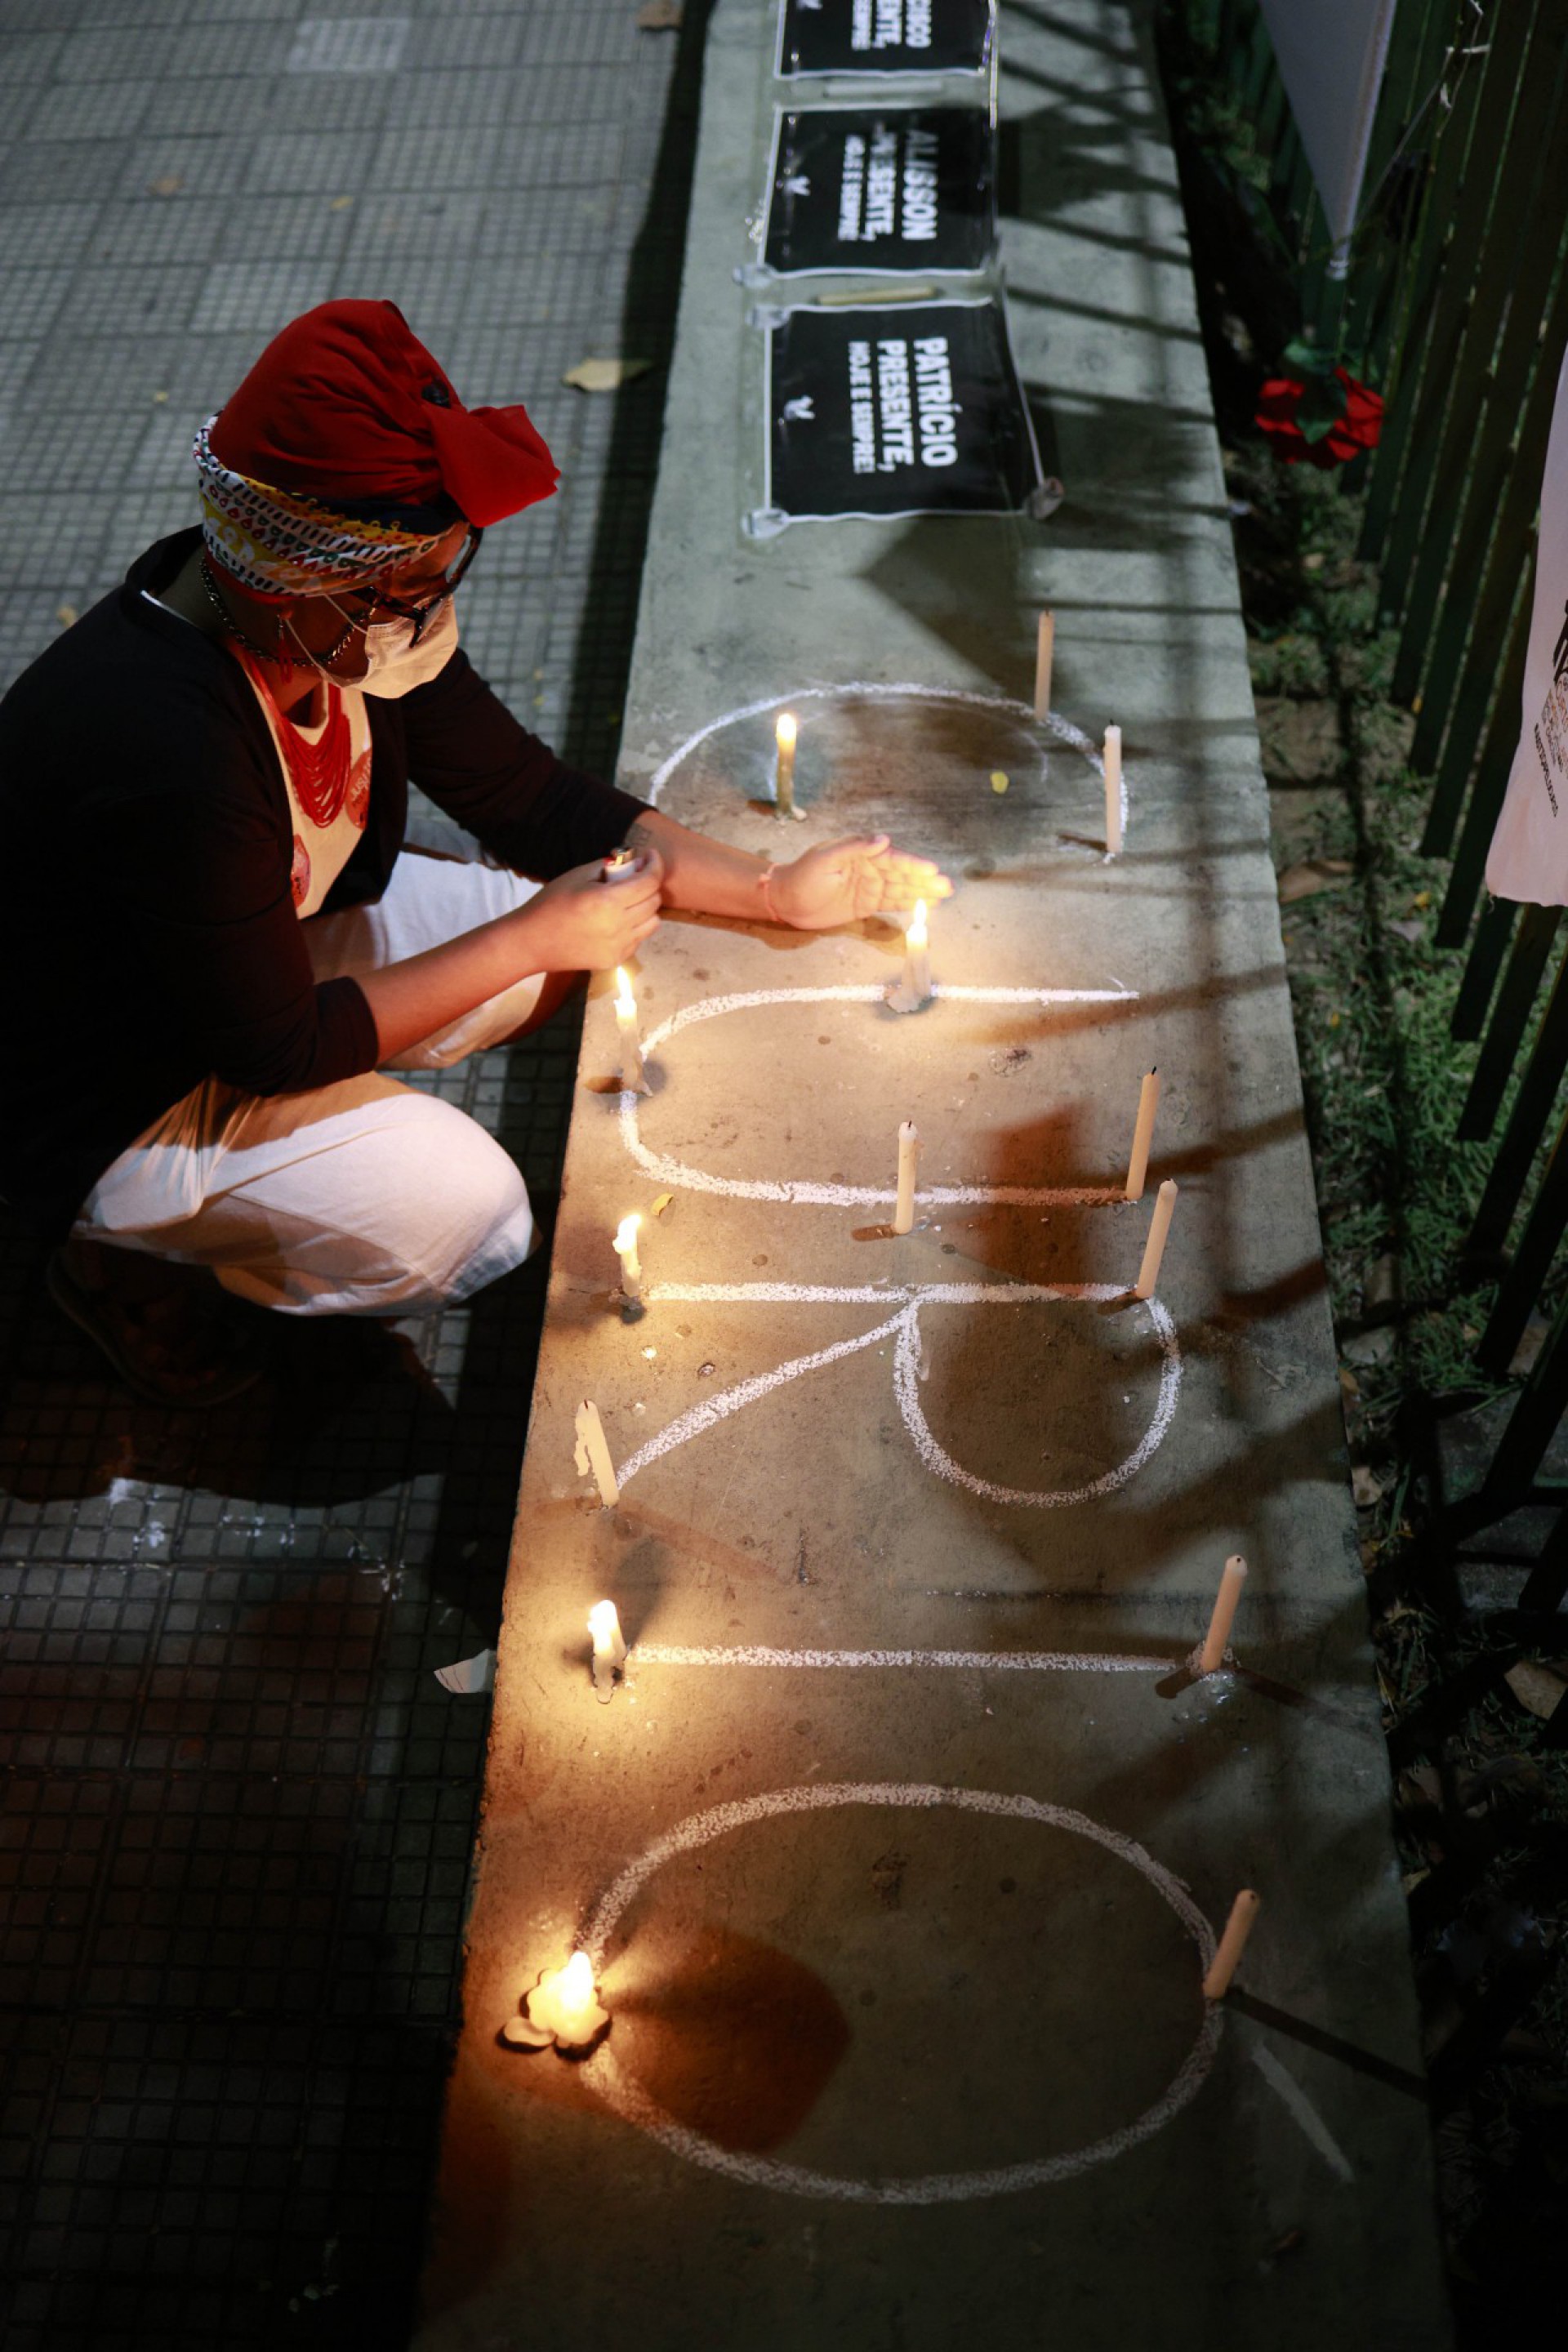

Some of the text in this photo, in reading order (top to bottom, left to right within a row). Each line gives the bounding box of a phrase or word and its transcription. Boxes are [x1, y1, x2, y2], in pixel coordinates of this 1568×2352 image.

[843, 171, 862, 181] E
[844, 135, 865, 169] HOJE
[860, 129, 897, 241] PRESENTE,
[902, 130, 938, 240] ALISSON
[849, 341, 871, 385] HOJE
[850, 386, 872, 399] E
[914, 336, 963, 467] PATRÍCIO
[877, 339, 914, 472] PRESENTE,
